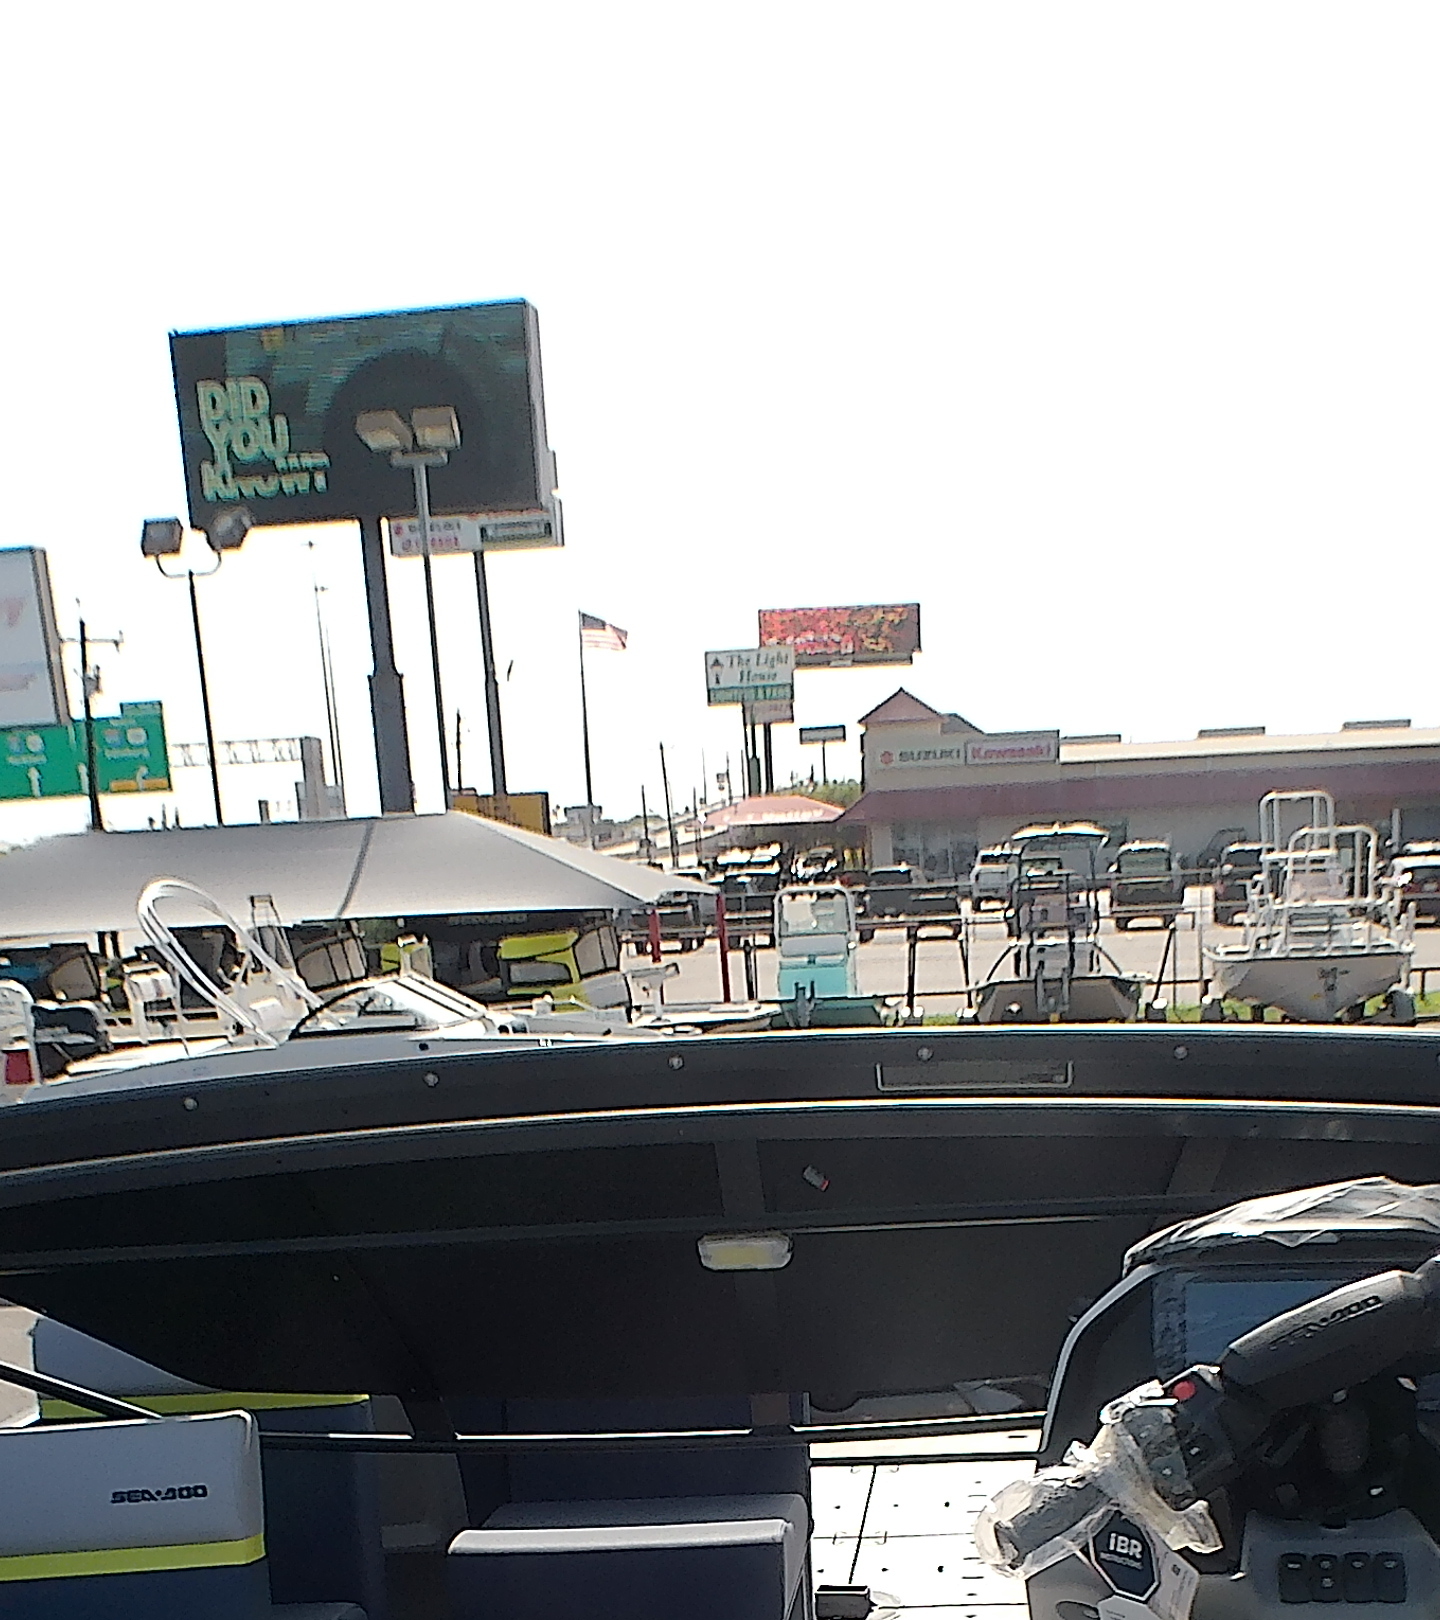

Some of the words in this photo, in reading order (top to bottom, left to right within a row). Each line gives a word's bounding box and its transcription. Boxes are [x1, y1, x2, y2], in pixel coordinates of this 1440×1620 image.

[197, 376, 271, 422] DID
[201, 412, 290, 464] YOU
[756, 651, 789, 669] Light
[898, 748, 961, 763] SUZUKI
